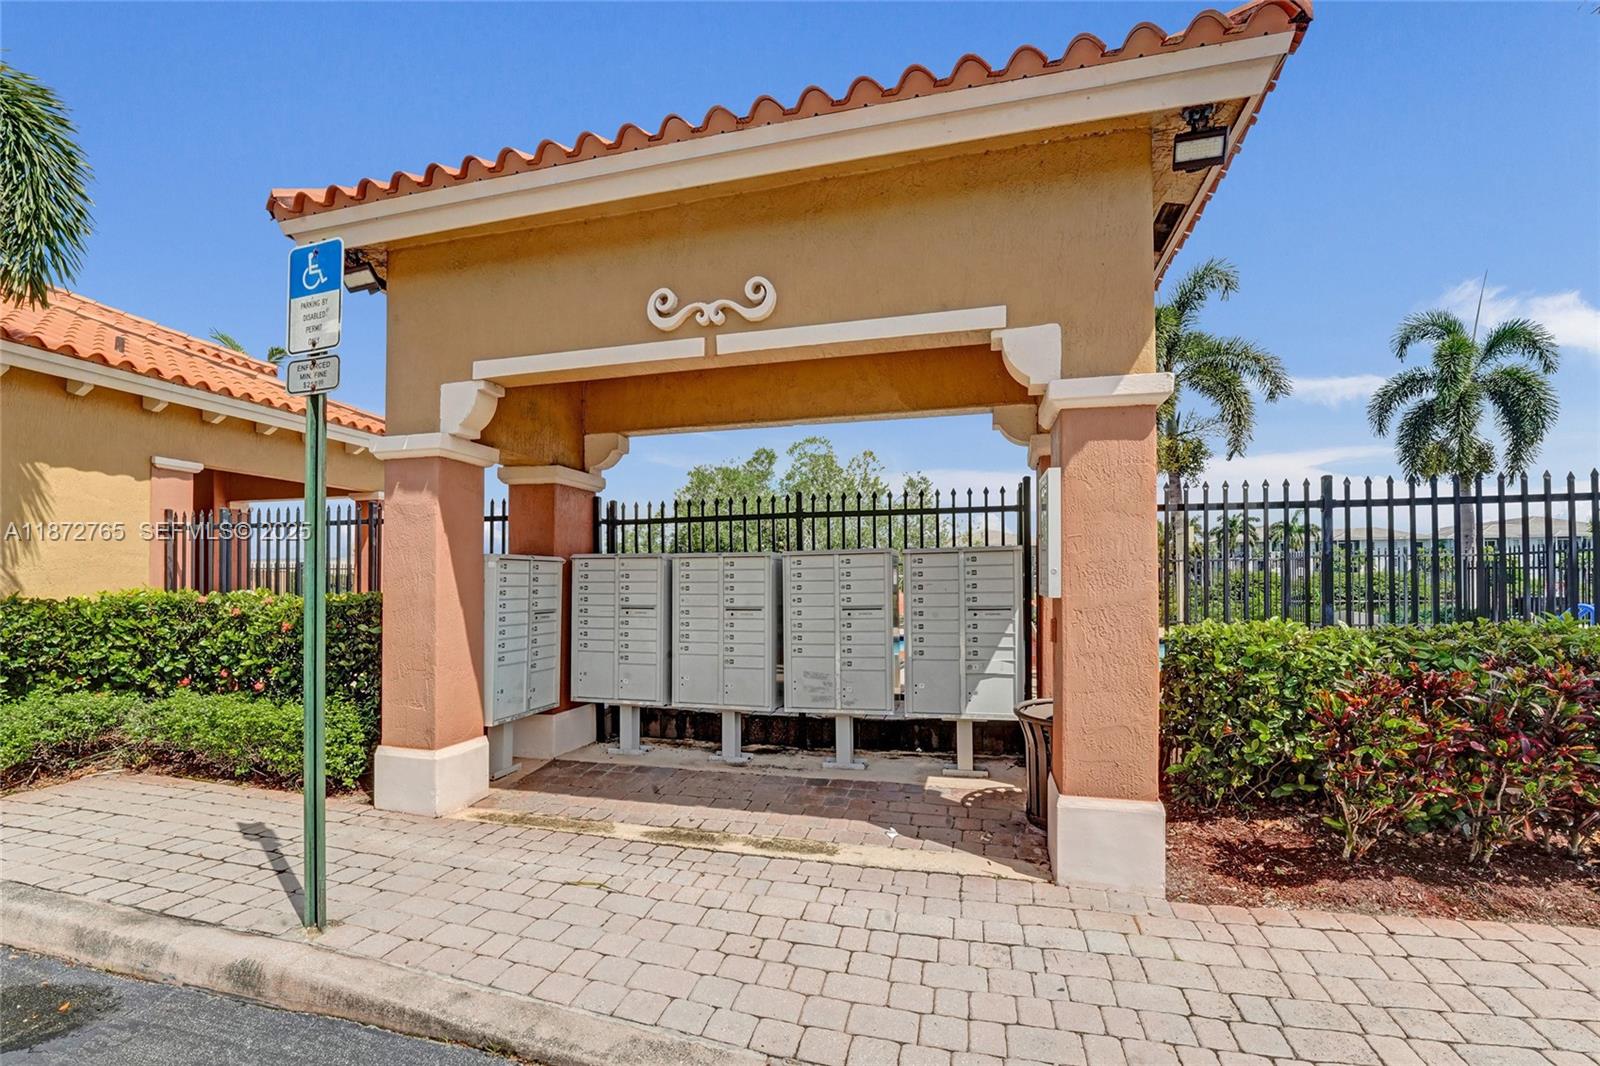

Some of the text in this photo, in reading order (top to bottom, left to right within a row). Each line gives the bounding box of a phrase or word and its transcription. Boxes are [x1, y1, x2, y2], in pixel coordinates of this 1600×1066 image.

[301, 298, 328, 309] PARKING BY
[303, 310, 326, 321] DISABLED
[305, 323, 322, 333] PERMIT
[297, 361, 330, 372] ENFORCED
[313, 370, 328, 379] FINE
